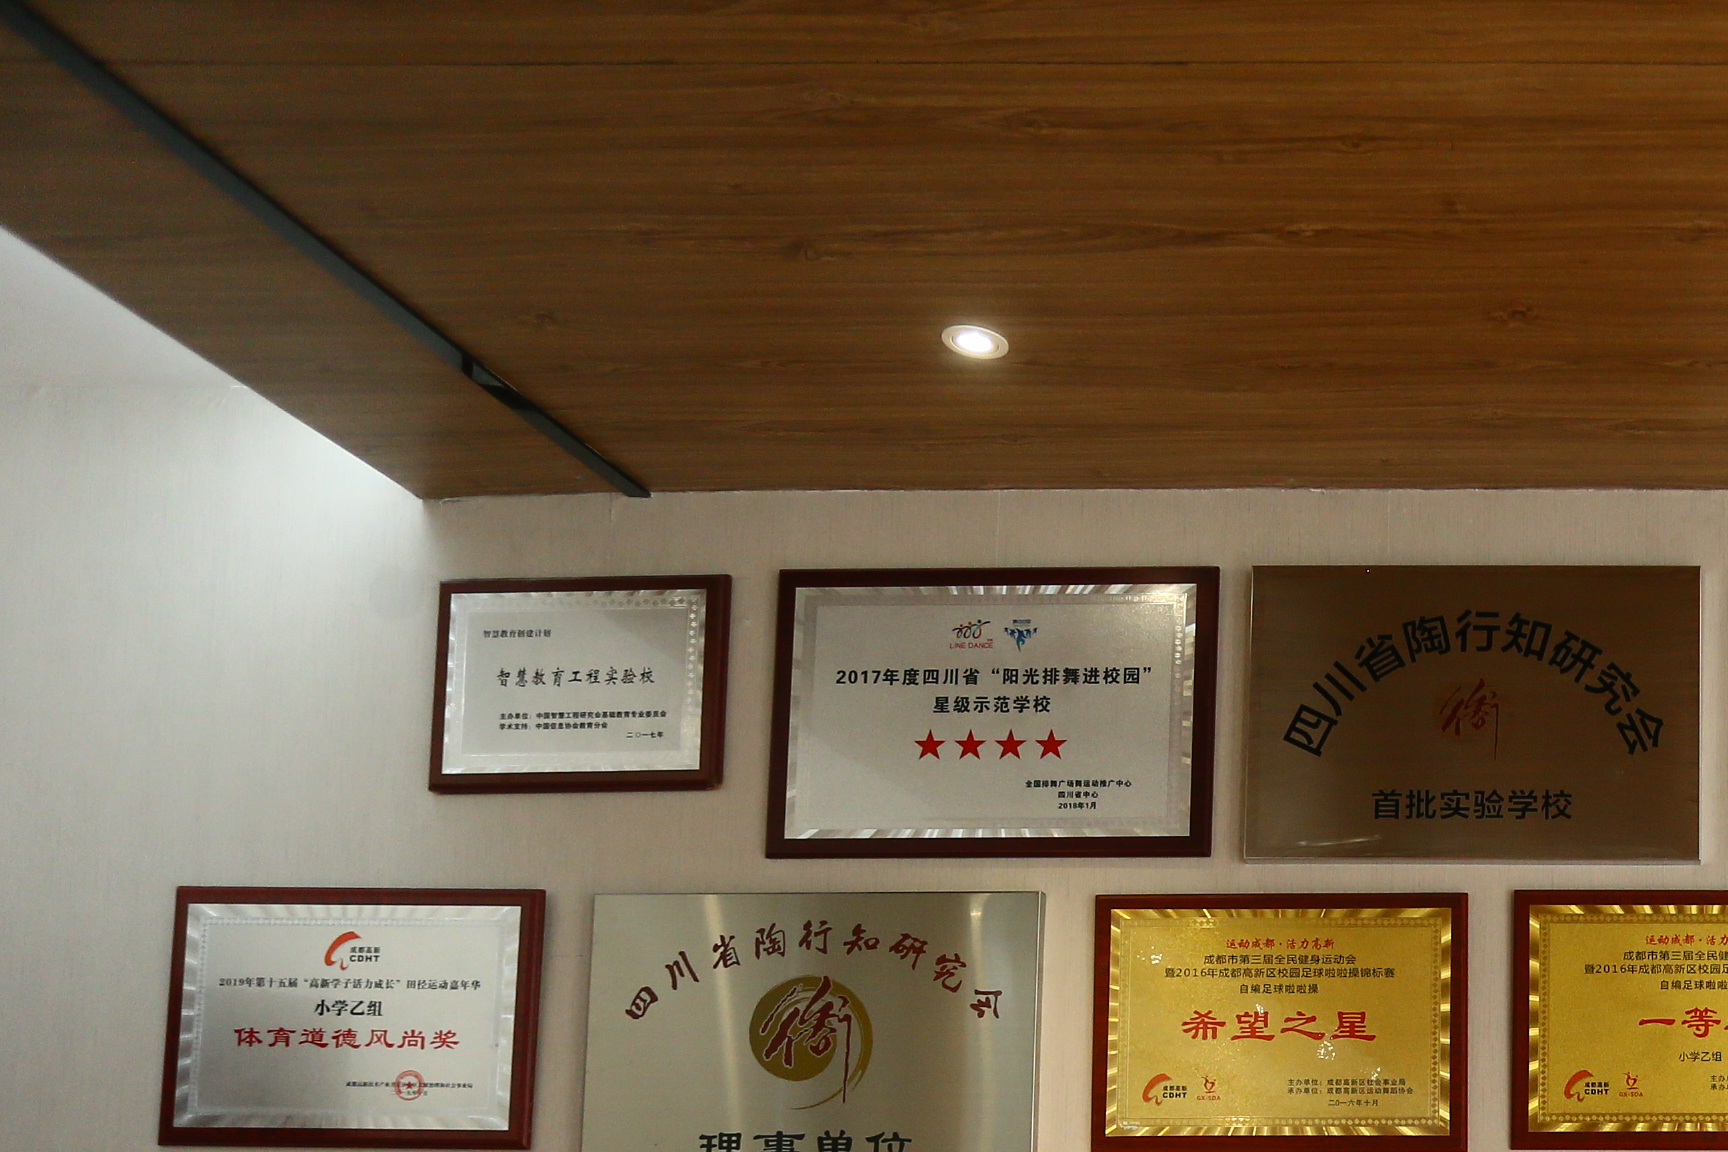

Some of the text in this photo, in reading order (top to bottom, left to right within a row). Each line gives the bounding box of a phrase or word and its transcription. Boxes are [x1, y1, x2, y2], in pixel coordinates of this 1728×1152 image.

[483, 629, 551, 639] 智慧教育创建计划
[496, 666, 656, 688] 智慧教育工程实验校
[835, 666, 1153, 686] 2017年度四川省“阳光排舞进校园”
[1282, 609, 1666, 758] 四川省陶行知研究会
[932, 695, 1052, 714] 星级示范学校
[1025, 779, 1132, 788] 全国排舞广场舞运动推广中心
[1058, 791, 1099, 799] 四川省中心
[1058, 801, 1097, 810] 2018年1月
[1371, 789, 1573, 820] 首批实验学校
[350, 946, 381, 954] 成都高新
[349, 954, 381, 963] CDHT
[1203, 953, 1357, 966] 成都市第三届全民健身运动会
[625, 919, 1003, 1020] 四川省陶行知研究会
[1164, 967, 1396, 979] 暨2016年成都高新区校园足球啦啦操锦标赛
[1239, 983, 1319, 995] 自编足球啦啦操
[314, 1000, 384, 1016] 小学乙组
[1181, 1009, 1377, 1042] 希望之星
[233, 1026, 460, 1050] 体育道德风尚奖
[1678, 1051, 1723, 1062] 小学乙组
[1287, 1078, 1406, 1086] 主办单位：成都高新区社会事业局
[1162, 1091, 1188, 1099] CDHT
[1584, 1088, 1610, 1096] CDHT
